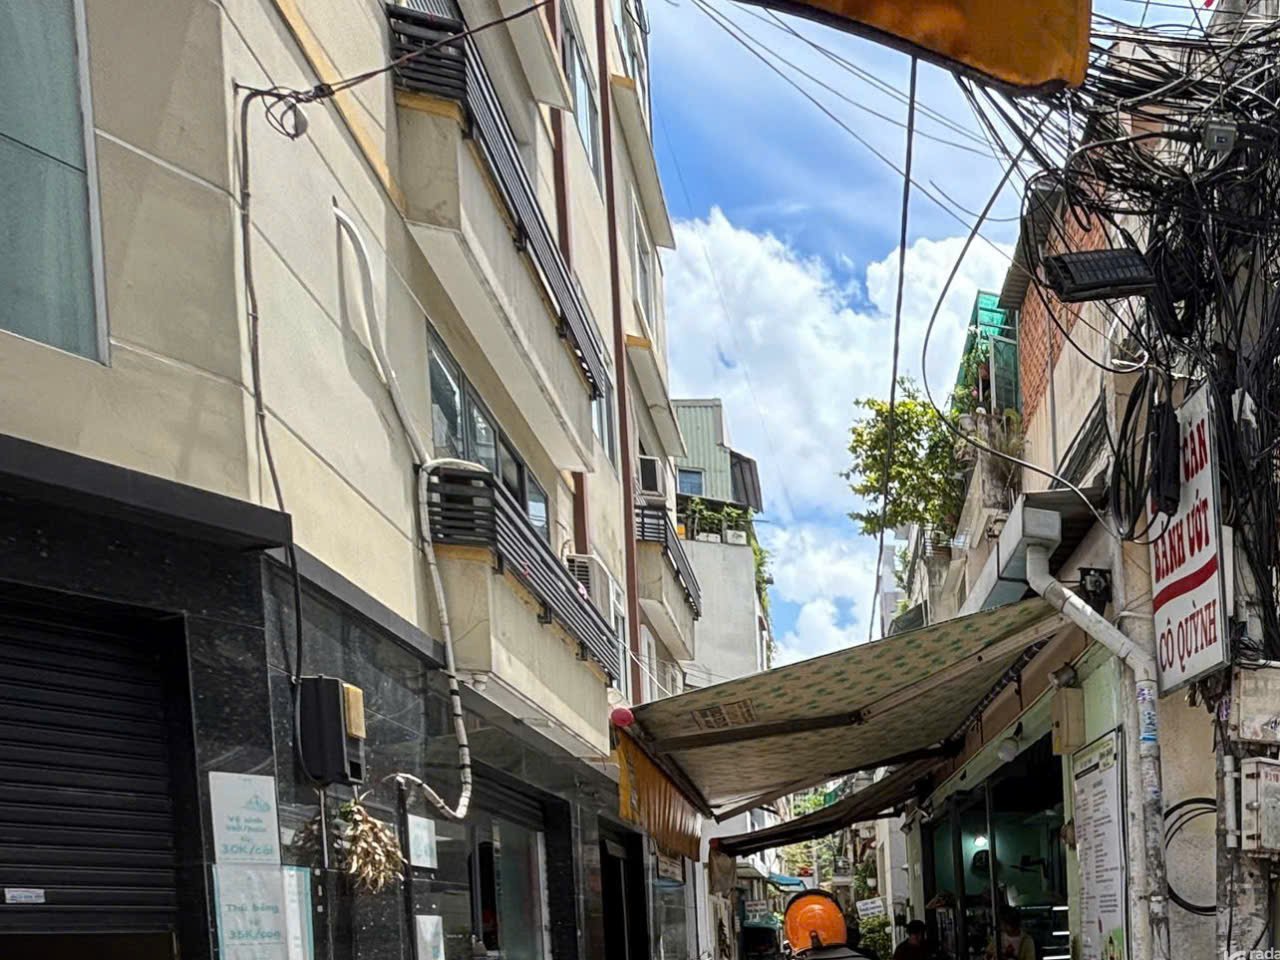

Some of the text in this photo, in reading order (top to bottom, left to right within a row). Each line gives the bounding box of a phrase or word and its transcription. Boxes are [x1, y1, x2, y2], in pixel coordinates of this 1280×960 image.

[1183, 418, 1208, 482] CĂN
[1187, 488, 1209, 557] ƯỚT
[1159, 600, 1218, 673] CÔ QUỲNH
